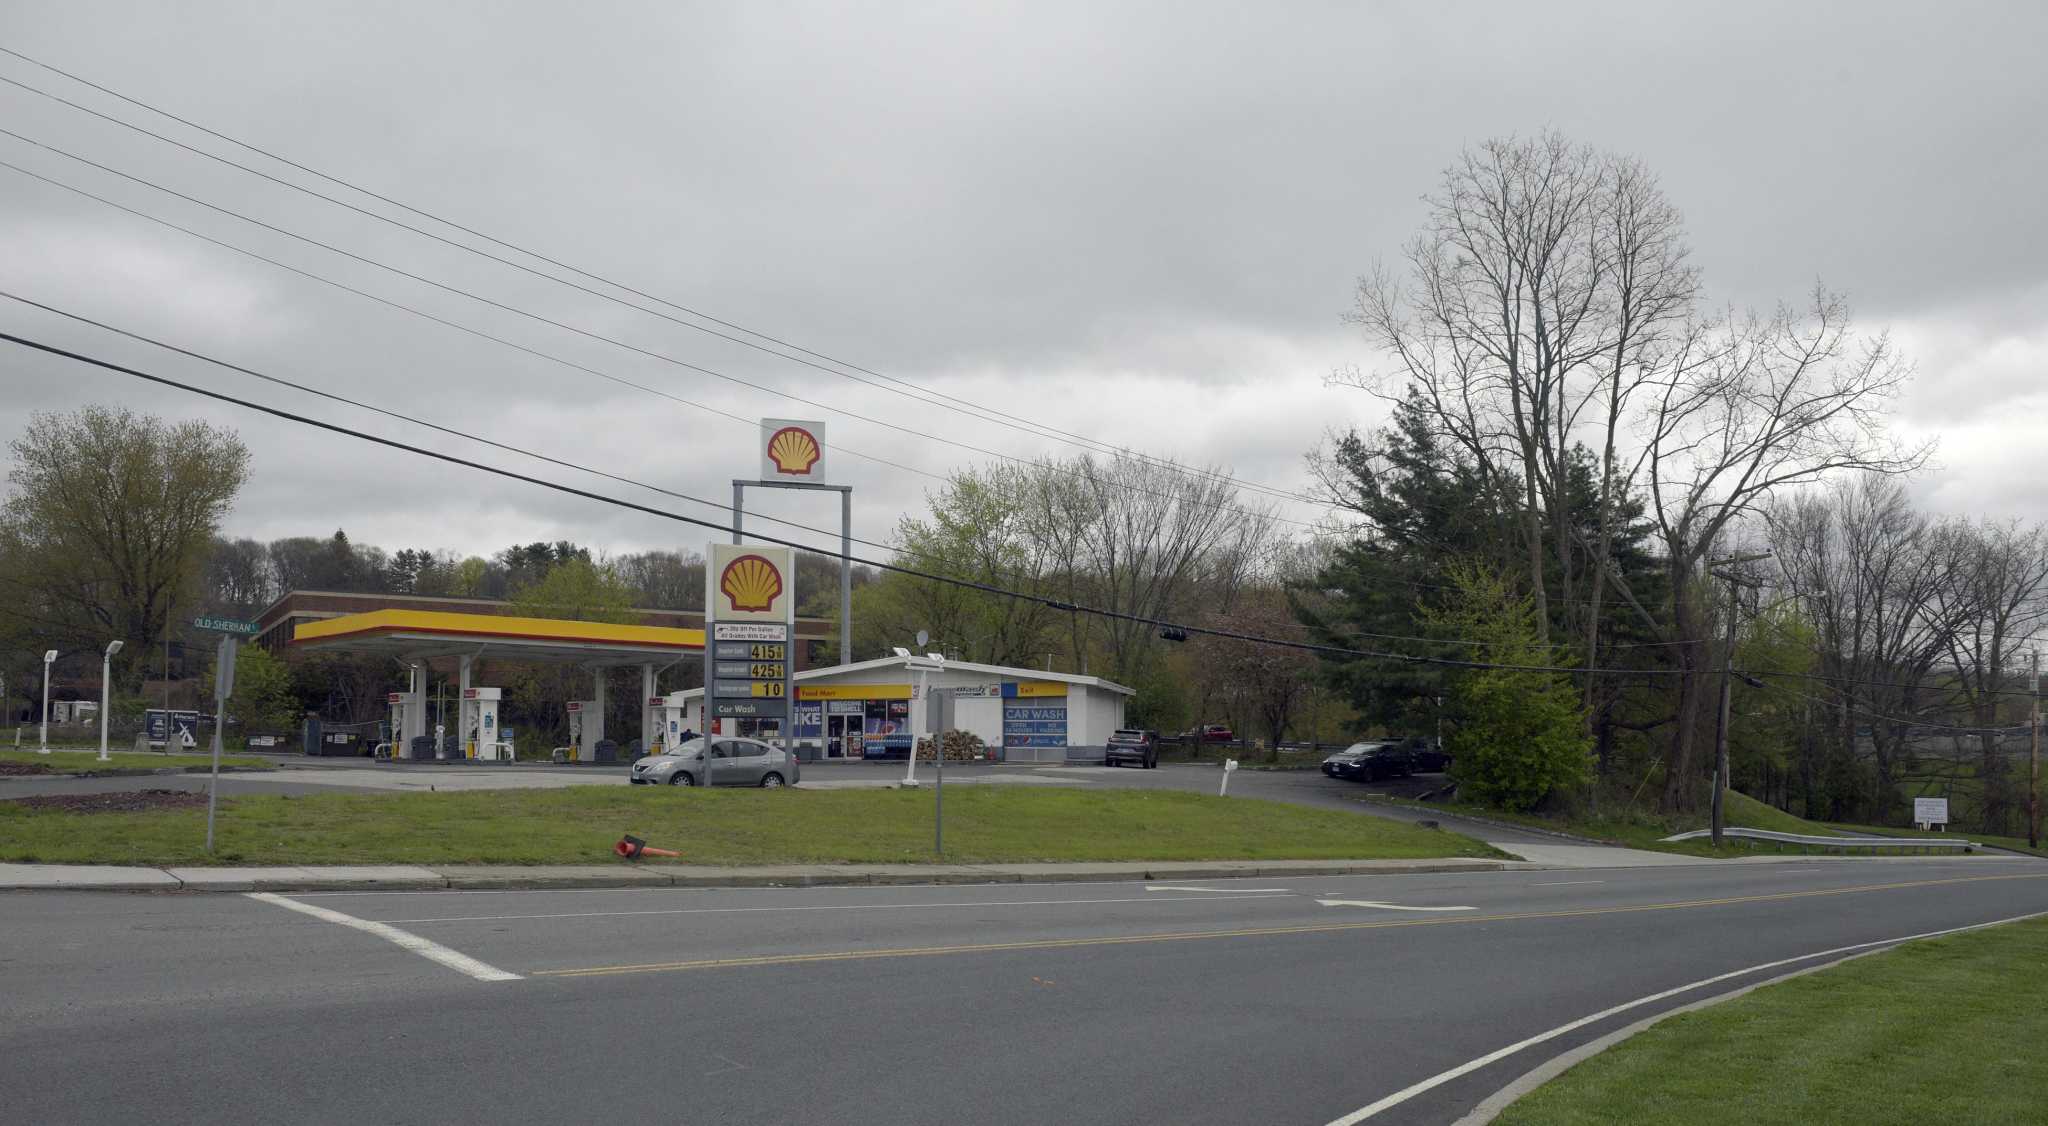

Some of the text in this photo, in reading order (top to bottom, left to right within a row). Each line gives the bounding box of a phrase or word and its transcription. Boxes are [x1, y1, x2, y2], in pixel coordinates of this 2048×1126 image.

[194, 617, 210, 628] OLD
[212, 620, 250, 632] SHERMAN
[752, 645, 775, 659] 415
[752, 664, 775, 677] 425
[719, 704, 756, 713] Car Wash
[1005, 710, 1064, 720] CAR WASH
